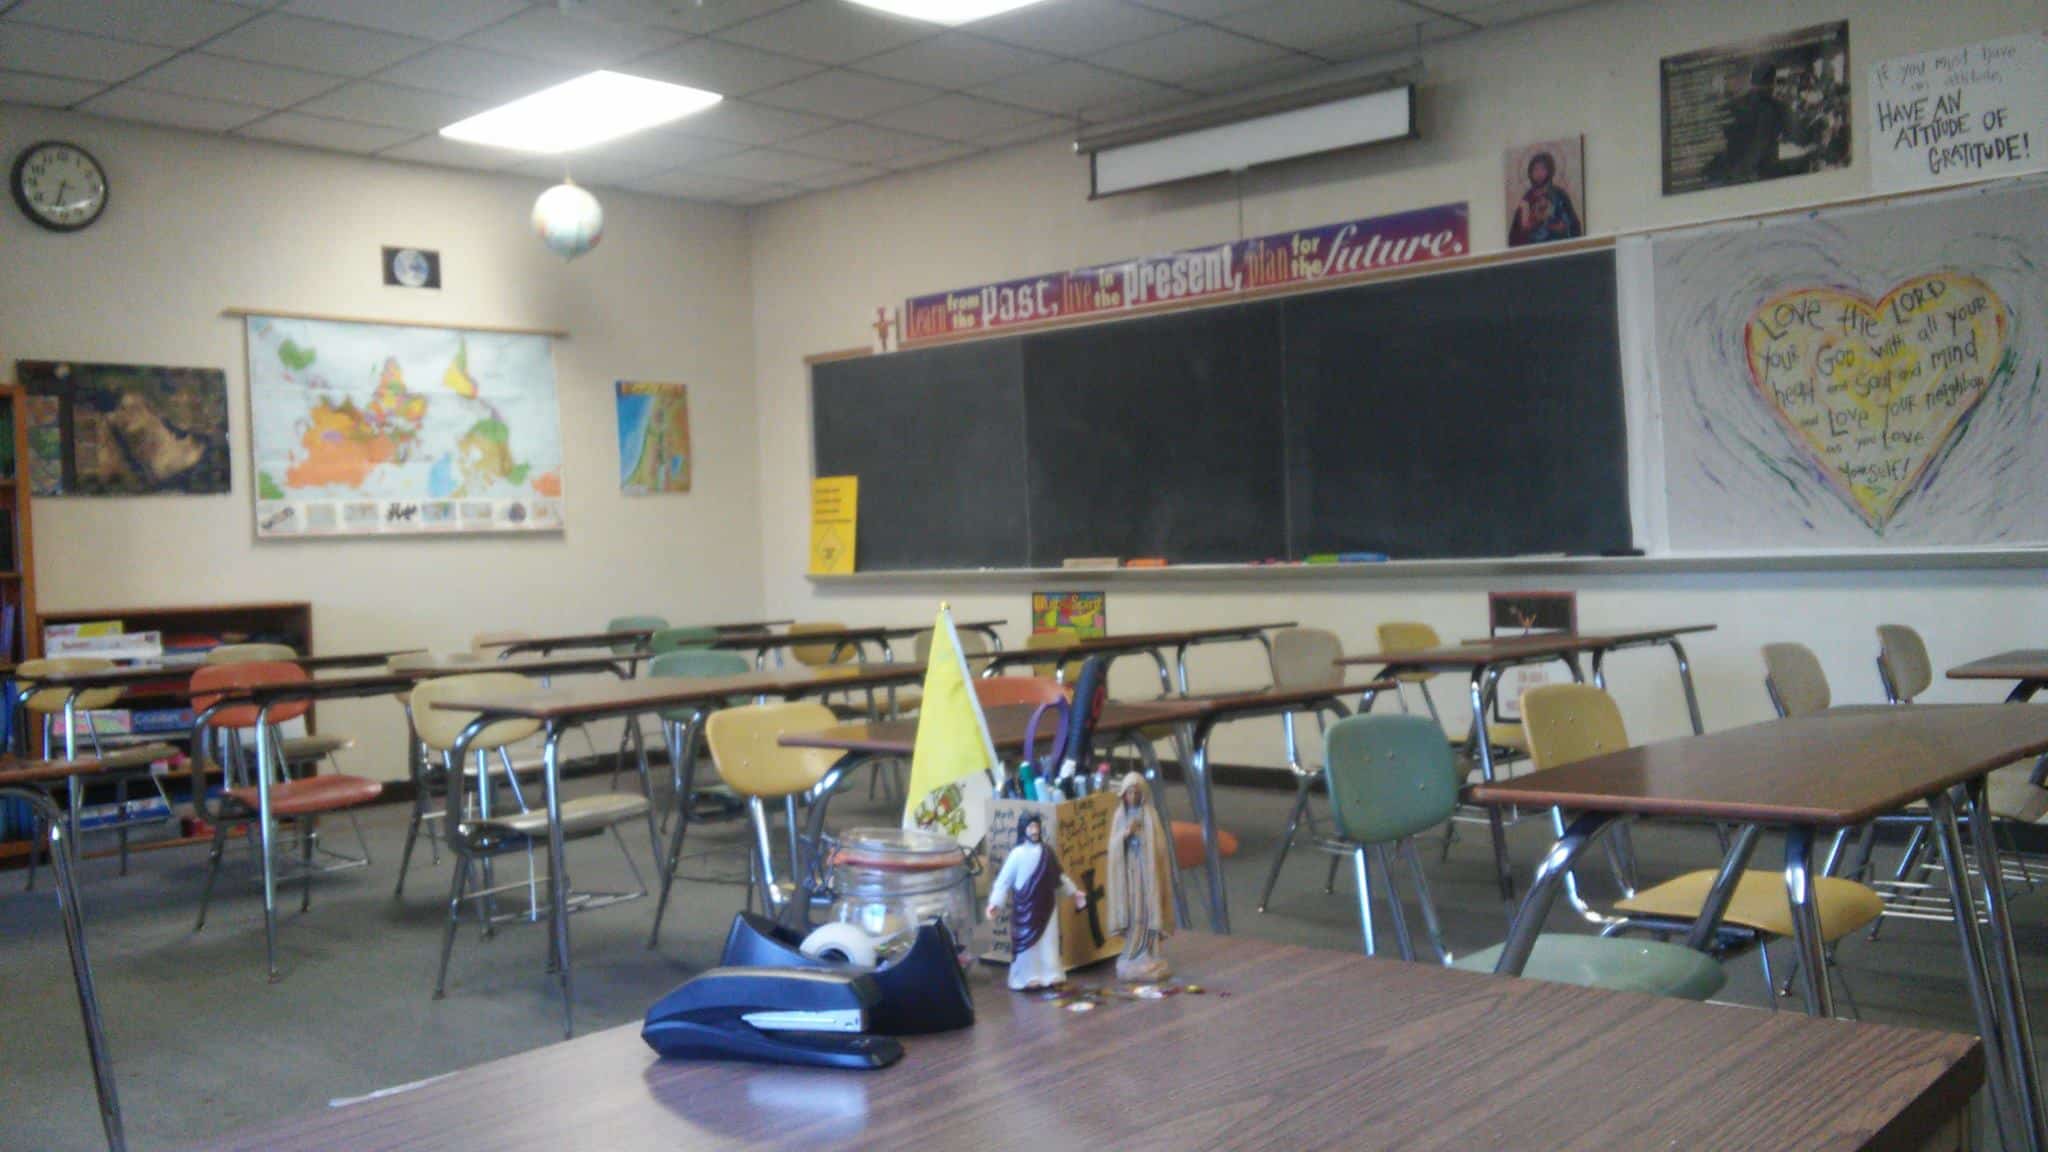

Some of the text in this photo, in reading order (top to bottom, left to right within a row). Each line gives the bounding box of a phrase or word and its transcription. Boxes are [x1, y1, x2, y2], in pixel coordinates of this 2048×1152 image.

[1877, 87, 1961, 132] HAVE AN
[1894, 107, 2008, 149] ATTITUDE OF
[1928, 131, 2031, 174] GRATITUDE!
[1246, 239, 1289, 290] plan
[1292, 233, 1320, 257] for
[1321, 223, 1463, 276] future.
[1123, 244, 1243, 309] present,
[1291, 254, 1323, 281] the
[981, 279, 1059, 330] past,
[1063, 270, 1092, 314] live
[1094, 286, 1121, 308] the
[909, 298, 947, 337] learn
[1917, 313, 1938, 342] all
